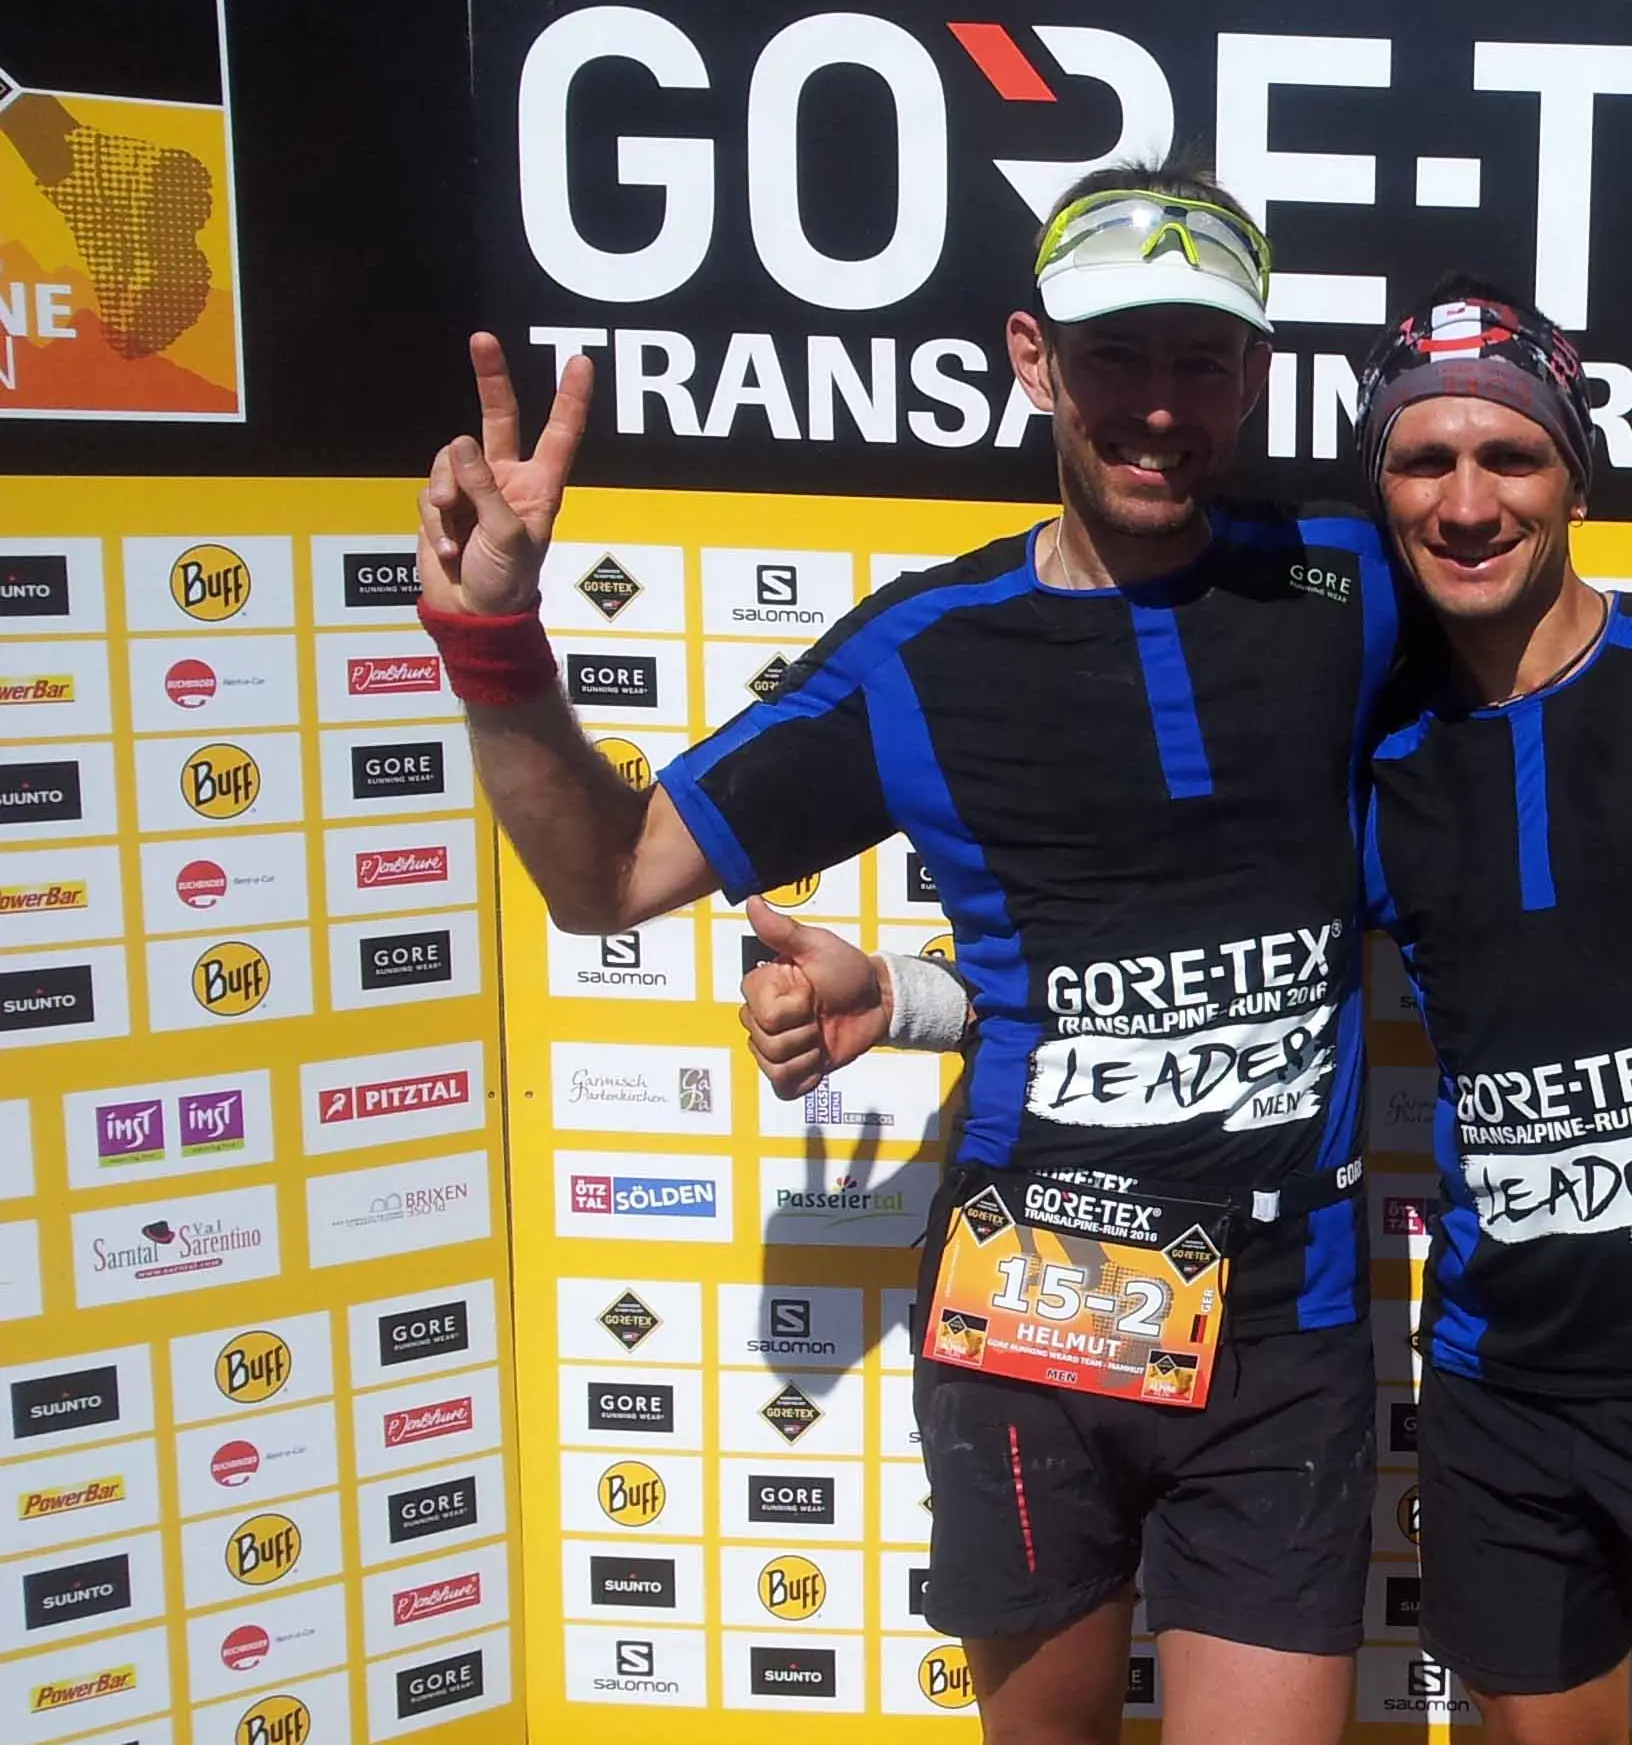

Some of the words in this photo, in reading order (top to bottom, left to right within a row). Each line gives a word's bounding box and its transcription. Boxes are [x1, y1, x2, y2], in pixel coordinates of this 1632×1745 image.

[0, 583, 50, 598] UNTO
[584, 580, 633, 593] GORE-TEX
[1289, 564, 1353, 595] GORE
[580, 667, 645, 686] GORE
[366, 756, 431, 775] GORE
[373, 944, 440, 967] GORE
[3, 995, 76, 1014] SUUNTO
[366, 1083, 462, 1111] PITZTAL
[1253, 1091, 1301, 1118] MEN
[1336, 1157, 1362, 1189] GOR
[405, 1183, 468, 1207] BRIXEN
[575, 1182, 608, 1197] ÖTZ
[616, 1183, 714, 1212] SÖLDEN
[776, 1187, 903, 1212] Passeiertal
[576, 1196, 608, 1209] TAL
[1024, 1208, 1128, 1240] TRANSALPINE-RUN
[1129, 1228, 1158, 1243] 2016
[93, 1238, 159, 1272] Sarntal
[178, 1225, 261, 1259] Sarentino
[992, 1256, 1166, 1338] 15-2
[1200, 1290, 1214, 1313] GER
[392, 1315, 456, 1343] GORE
[605, 1313, 652, 1327] GORE-TEX
[1016, 1322, 1121, 1357] HELMUT
[1046, 1369, 1078, 1382] MEN
[30, 1395, 102, 1419] SUUNTO
[600, 1395, 662, 1413] GORE
[766, 1407, 813, 1420] GORE-TEX
[24, 1481, 119, 1516] PowerBar
[401, 1491, 466, 1521] GORE
[761, 1487, 823, 1505] GORE
[42, 1583, 114, 1610] SUUNTO
[605, 1579, 662, 1593] SUUNTO
[409, 1666, 473, 1695] GORE
[764, 1670, 822, 1683] SUUNTO
[36, 1671, 131, 1709] PowerBar
